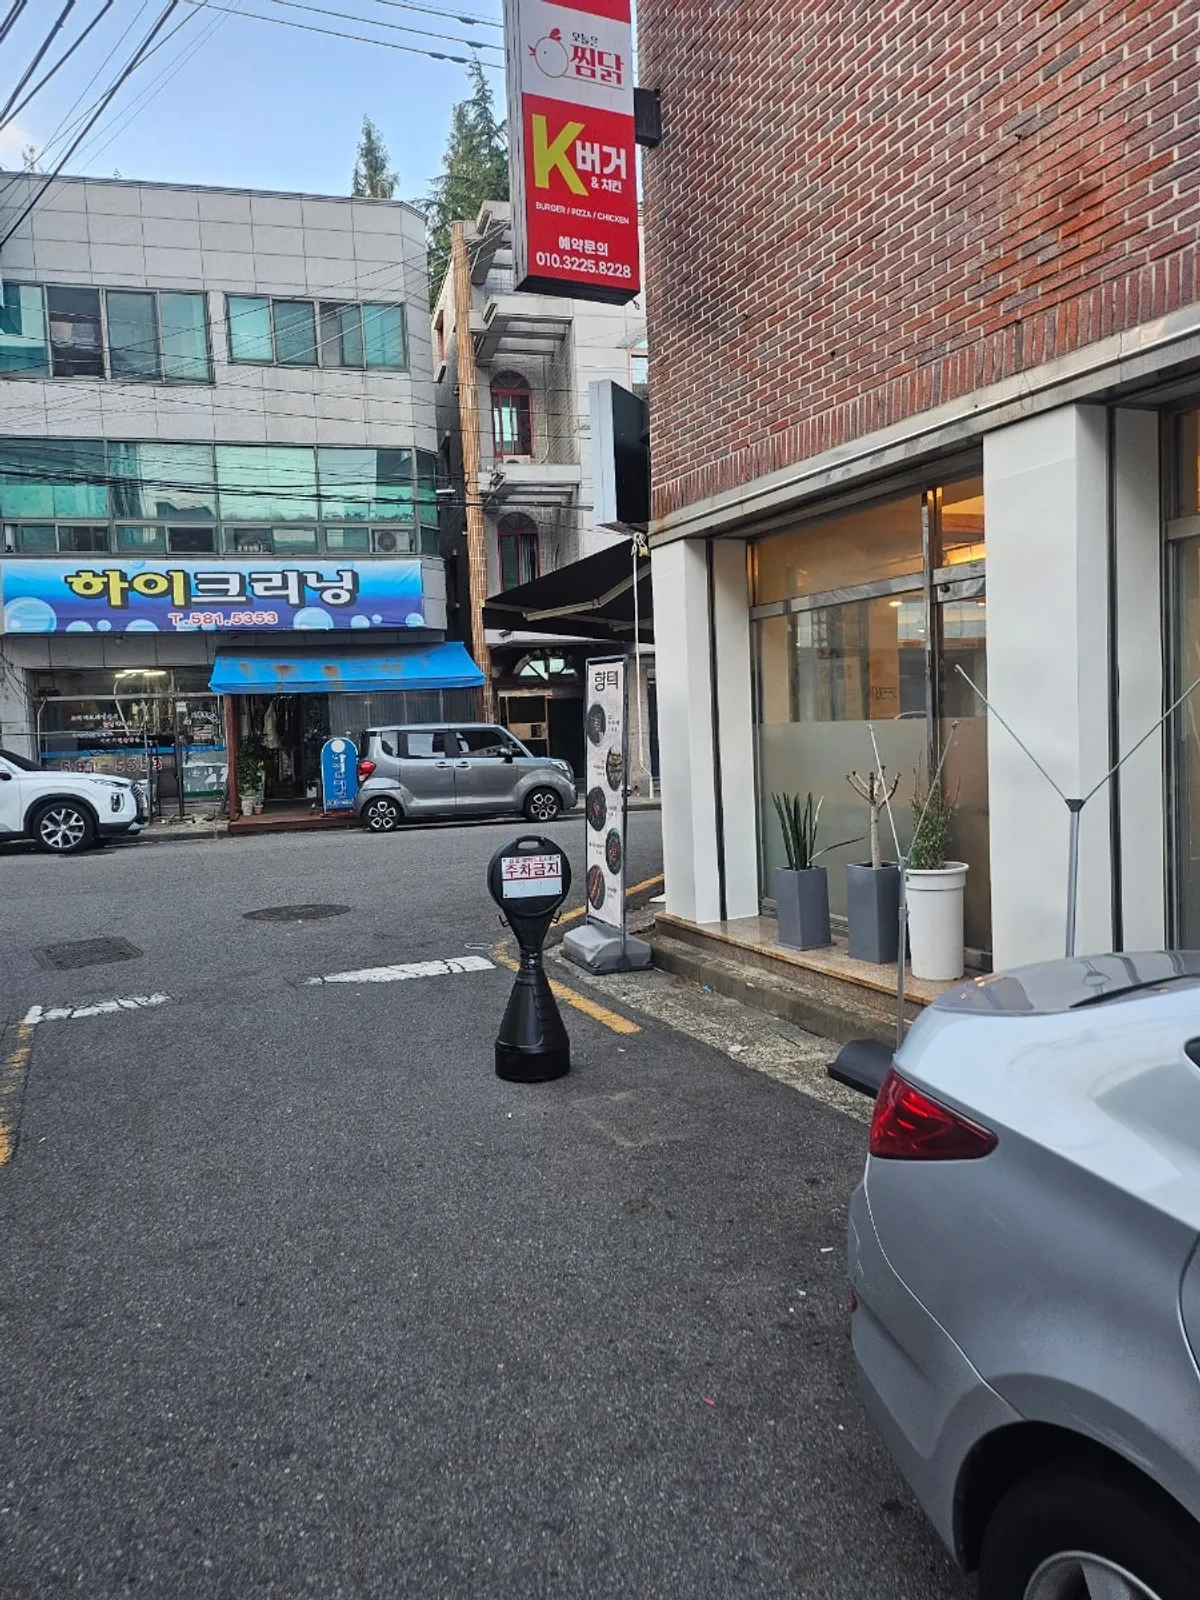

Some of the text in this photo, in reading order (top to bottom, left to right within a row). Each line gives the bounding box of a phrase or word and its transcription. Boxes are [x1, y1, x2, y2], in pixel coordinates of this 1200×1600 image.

[572, 31, 598, 47] 오늘은
[570, 44, 624, 85] 찜닭
[601, 178, 622, 193] 치킨
[535, 201, 566, 215] BURGER
[571, 207, 592, 218] PIZZA
[597, 212, 630, 225] CHICKEN
[558, 235, 608, 257] 예약문의
[535, 251, 632, 279] 010.3225.8228
[64, 570, 358, 607] 하이크리닝
[168, 611, 278, 626] T.581.5353
[505, 861, 559, 878] 주차금지
